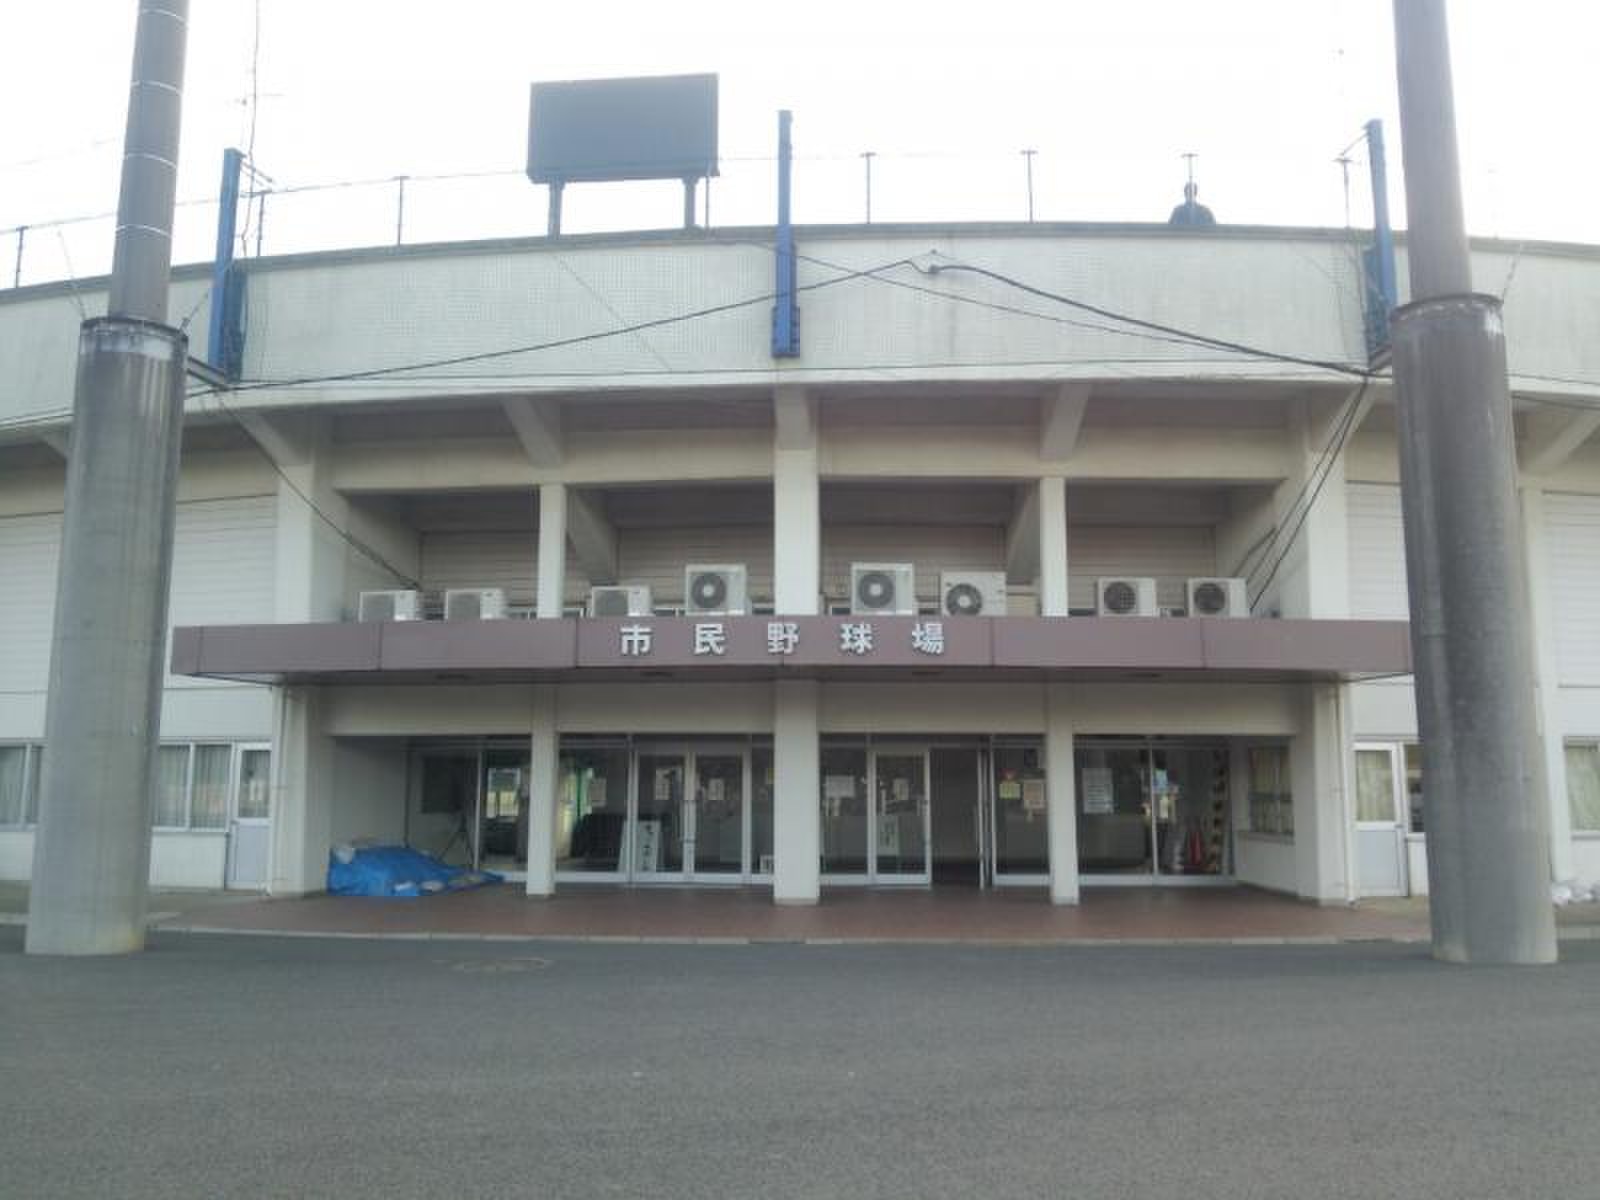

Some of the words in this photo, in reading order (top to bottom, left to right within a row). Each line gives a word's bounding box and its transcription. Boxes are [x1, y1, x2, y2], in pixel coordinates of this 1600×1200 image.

[620, 623, 945, 655] 市民野球場
